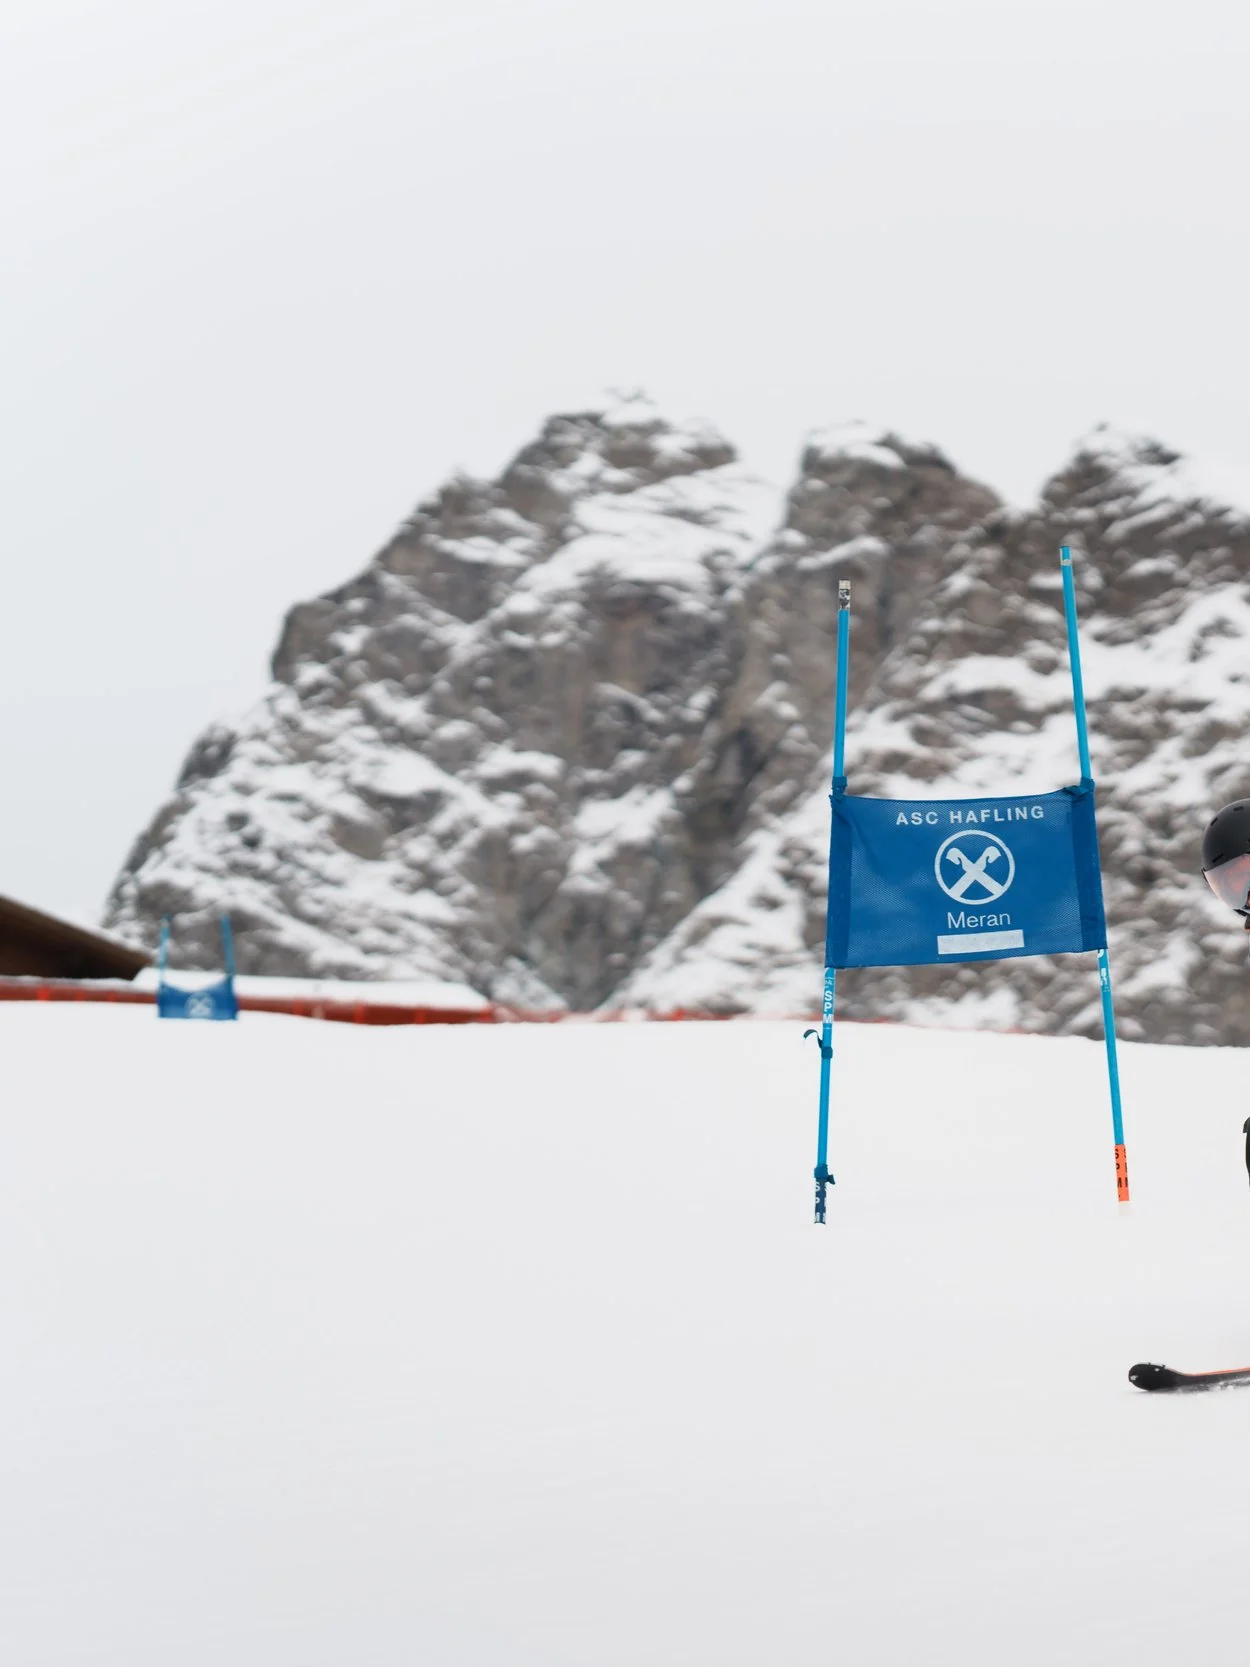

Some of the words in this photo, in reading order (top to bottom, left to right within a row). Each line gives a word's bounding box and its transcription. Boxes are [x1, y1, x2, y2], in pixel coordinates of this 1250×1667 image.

[895, 811, 939, 826] ASC
[949, 805, 1045, 824] HAFLING
[947, 911, 1011, 929] Meran
[823, 990, 834, 1024] SPM
